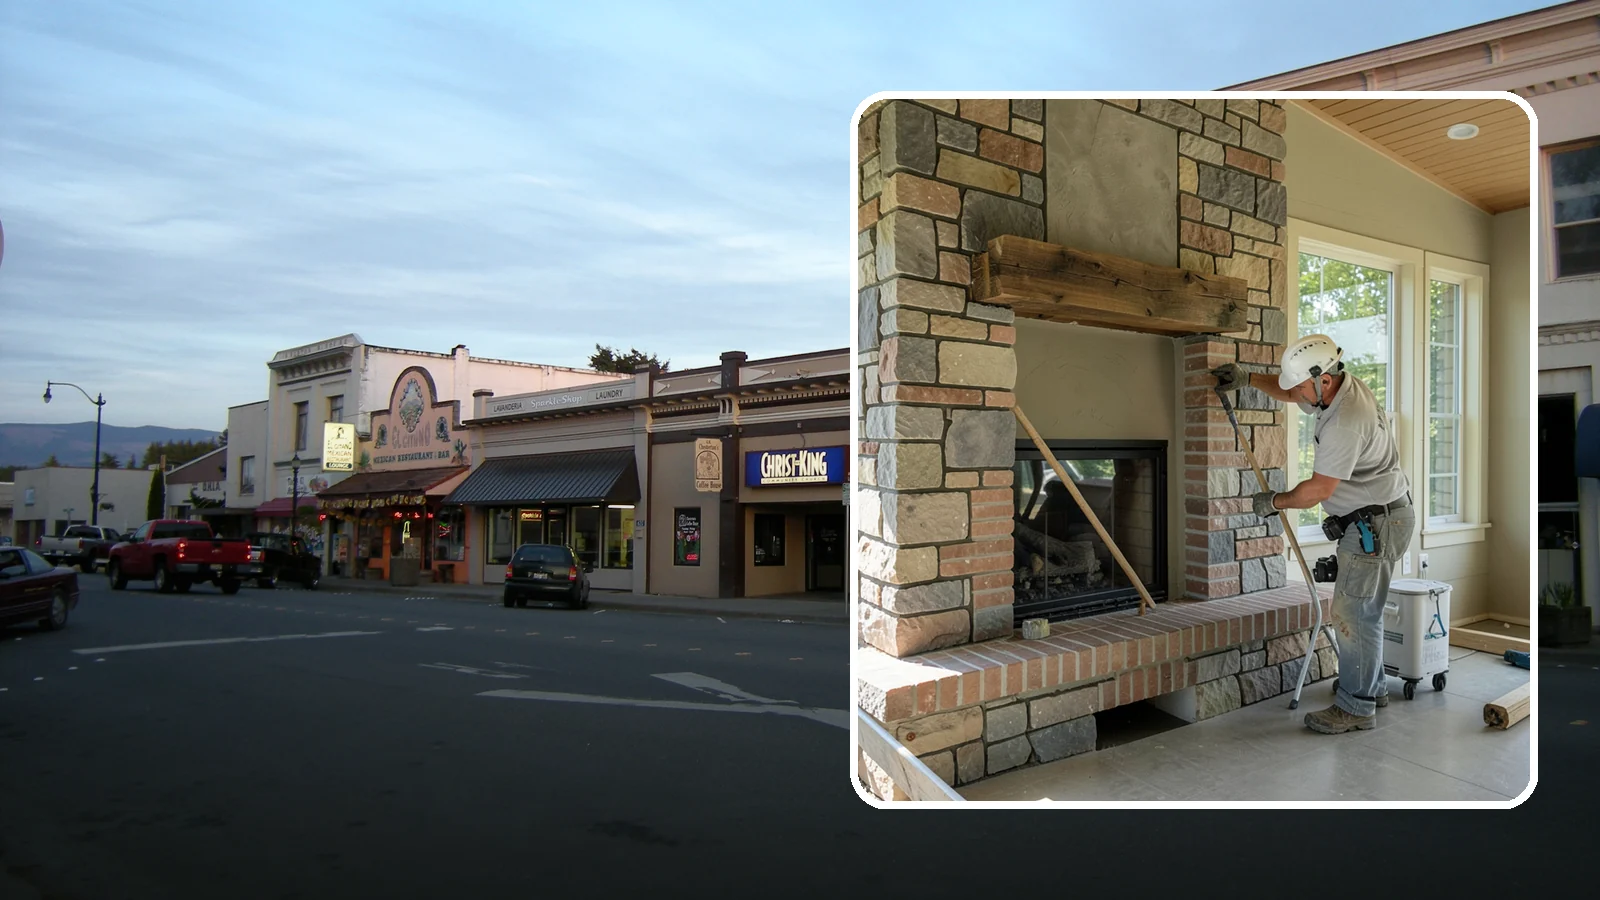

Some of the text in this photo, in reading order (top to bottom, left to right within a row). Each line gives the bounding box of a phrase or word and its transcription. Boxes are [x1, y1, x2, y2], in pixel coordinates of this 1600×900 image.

[596, 389, 624, 400] LAUNDRY
[493, 402, 523, 413] LAVANDERIA
[374, 450, 450, 464] MEXICAN RESTAURANT BAR
[799, 450, 827, 476] KING
[697, 480, 722, 489] Coffee House
